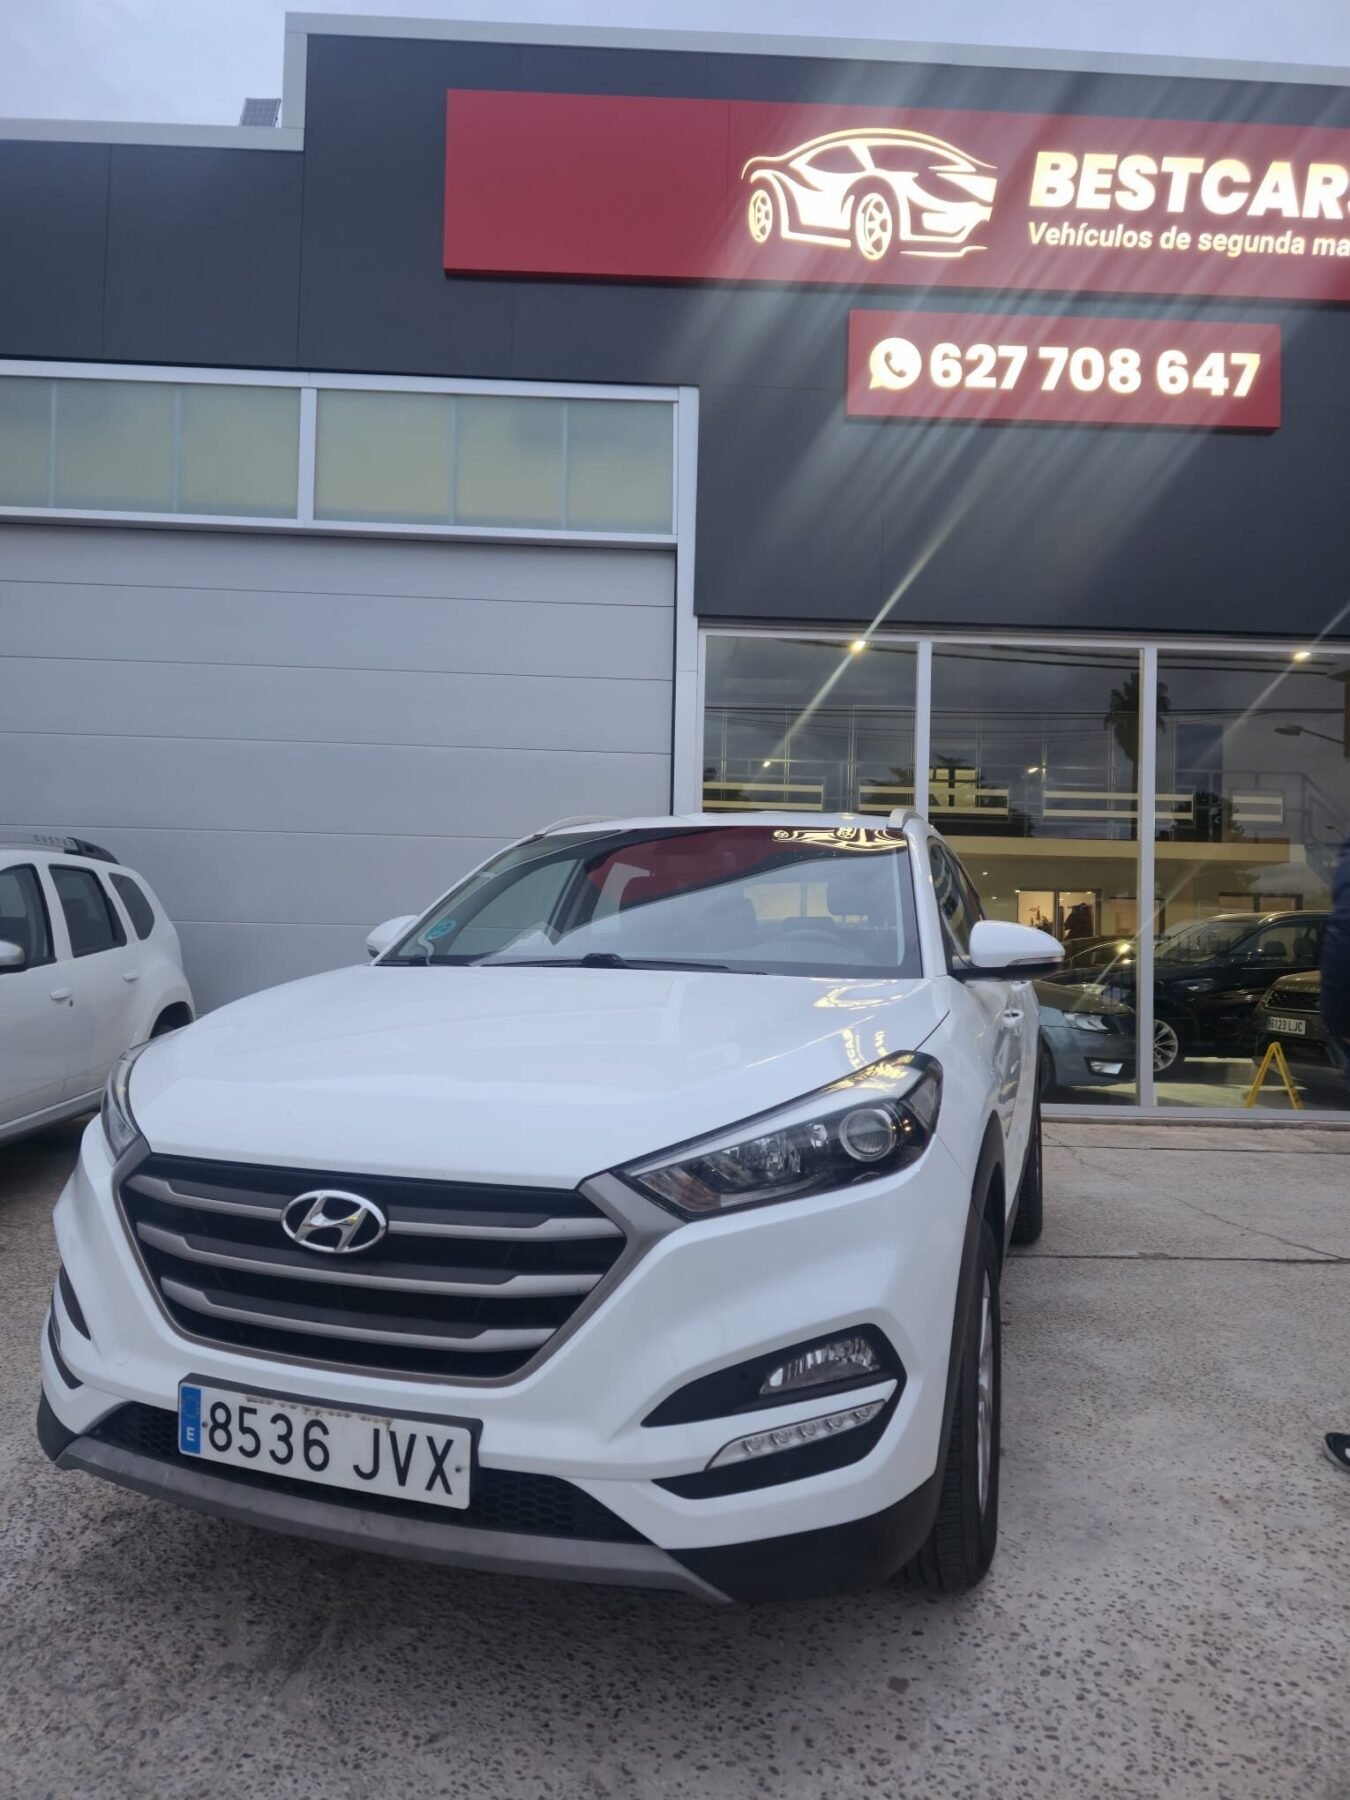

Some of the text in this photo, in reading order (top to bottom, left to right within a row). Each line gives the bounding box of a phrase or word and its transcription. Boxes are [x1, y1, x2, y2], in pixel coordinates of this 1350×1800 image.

[1029, 151, 1350, 220] BESTCAR
[1028, 221, 1153, 249] Vehículos
[1160, 226, 1191, 250] de
[1198, 231, 1305, 257] segunda
[930, 342, 1261, 398] 627 708 647
[186, 1427, 195, 1442] E
[208, 1401, 454, 1496] 8536 JVX
